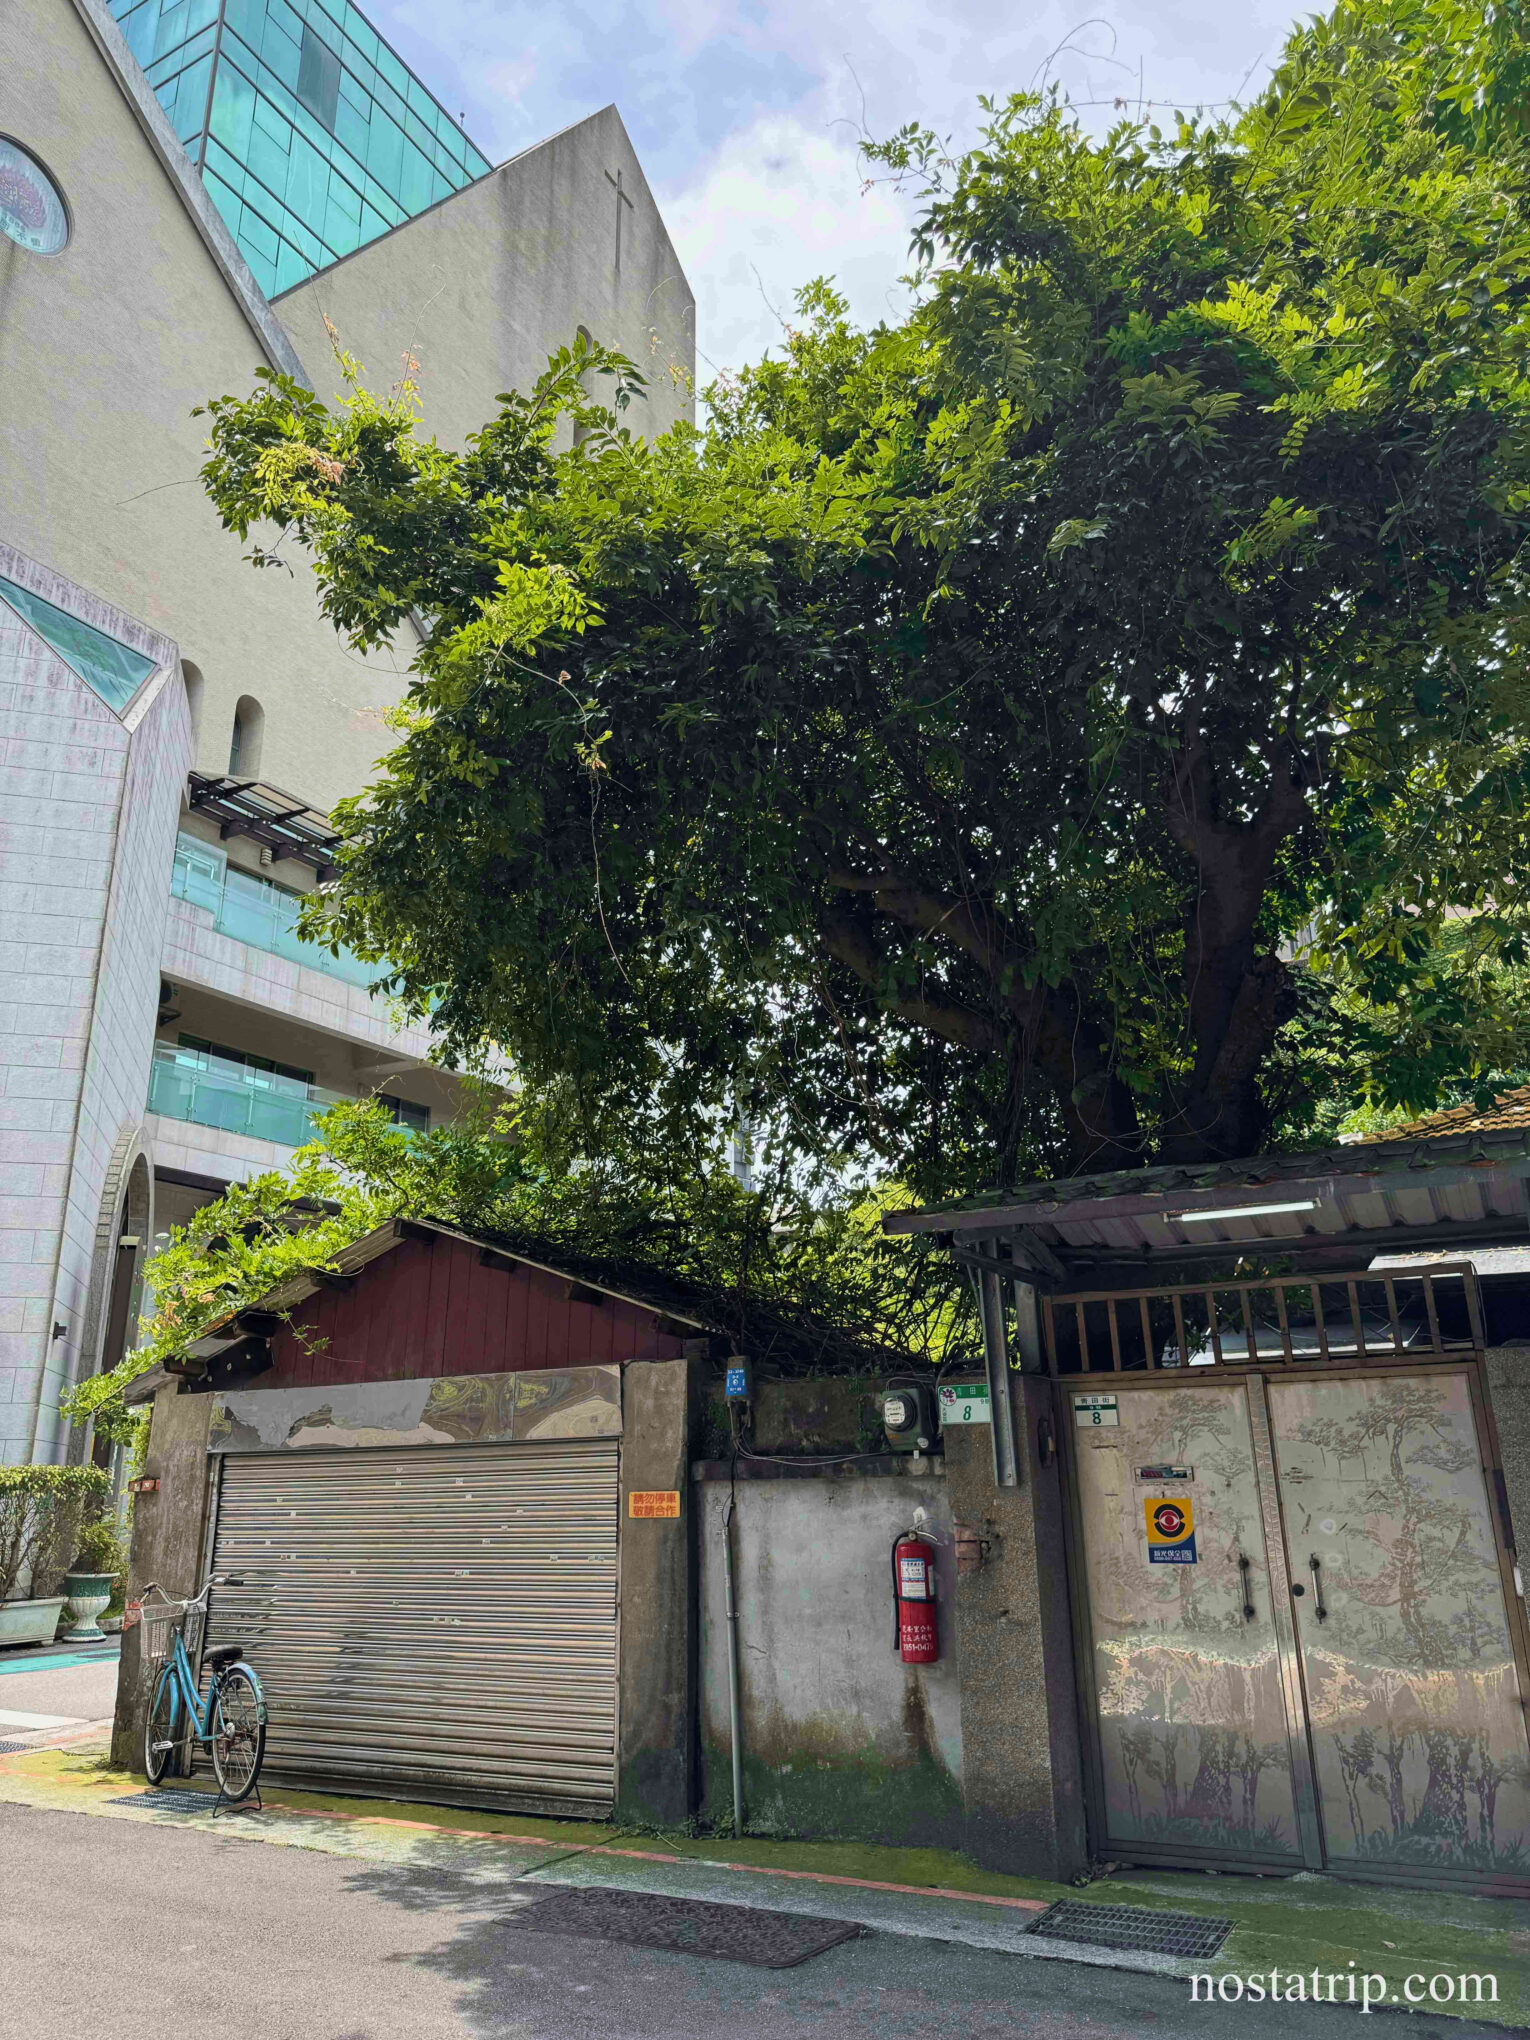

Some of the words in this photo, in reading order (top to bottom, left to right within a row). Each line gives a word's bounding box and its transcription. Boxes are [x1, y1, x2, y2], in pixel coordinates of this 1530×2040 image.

[963, 1405, 972, 1421] 8
[1092, 1411, 1101, 1425] 8
[633, 1493, 676, 1504] 請勿停車
[633, 1505, 676, 1517] 敬請合作
